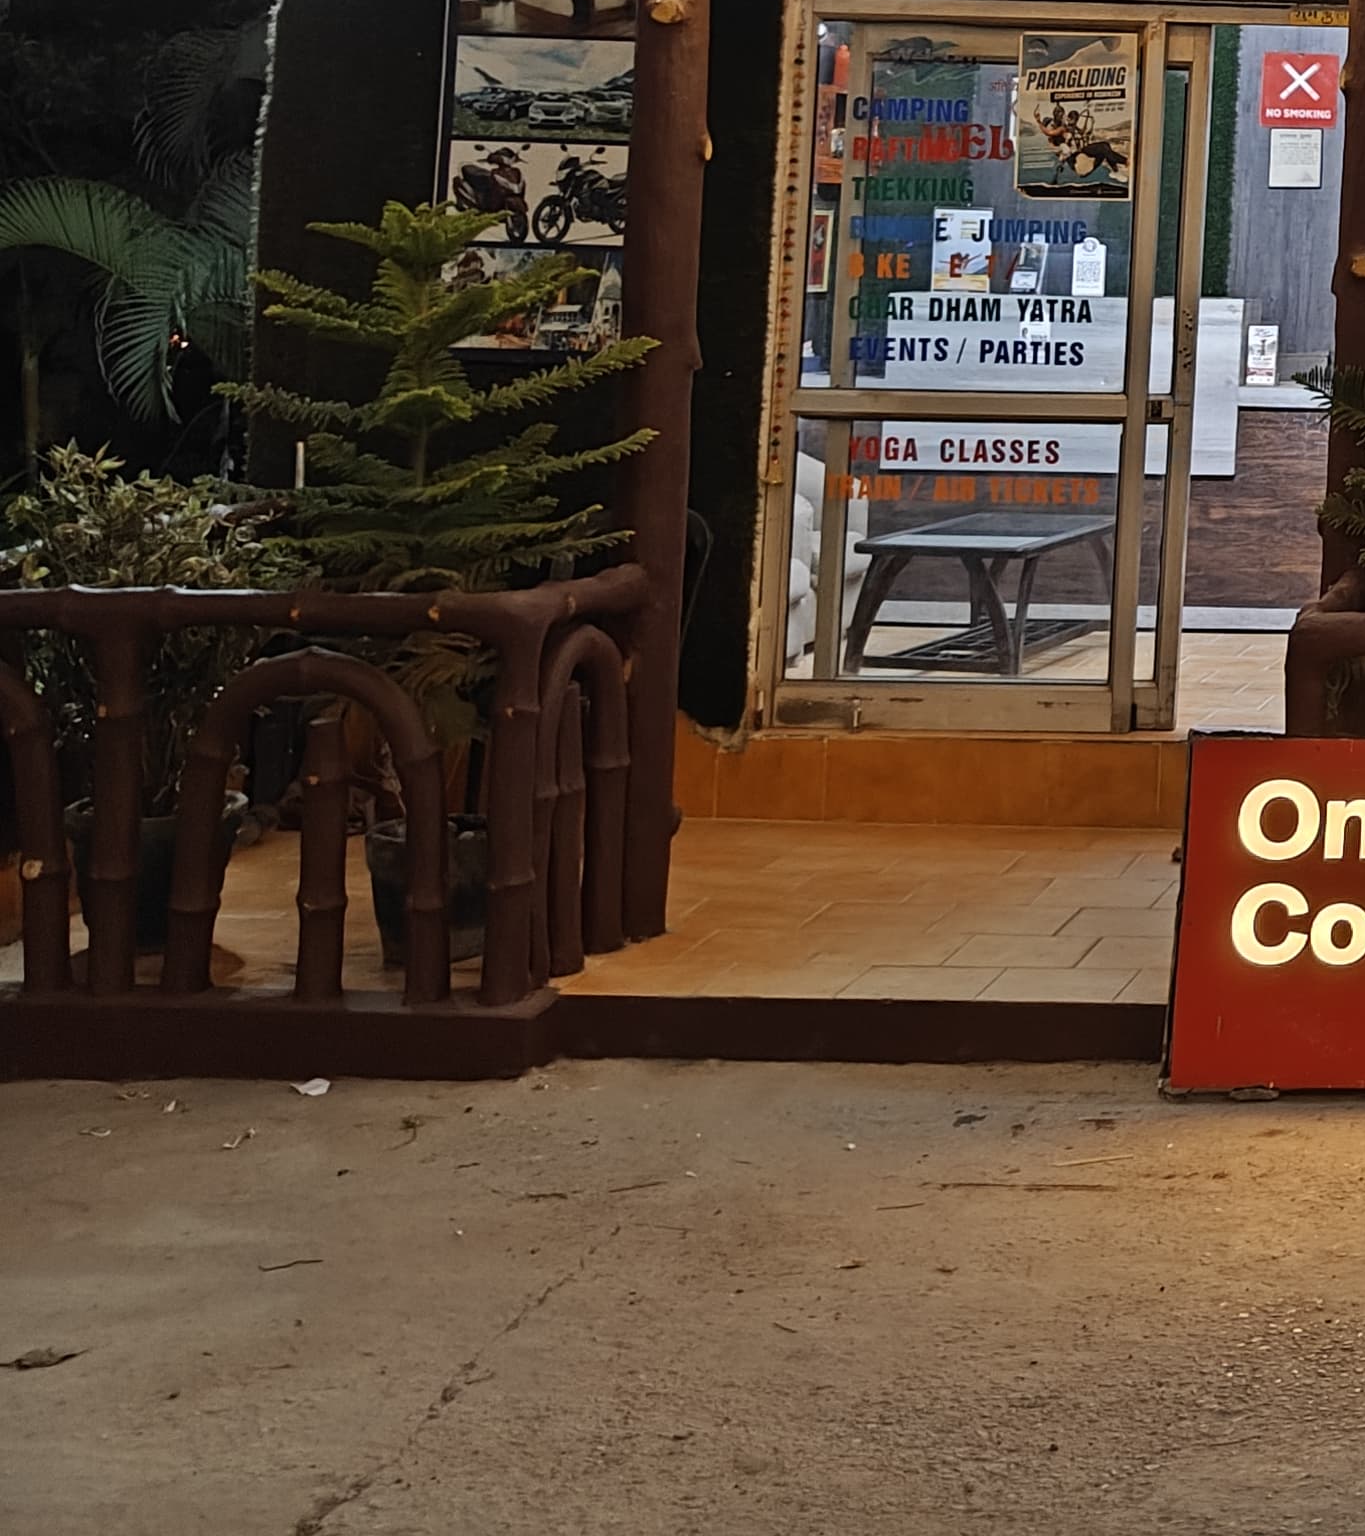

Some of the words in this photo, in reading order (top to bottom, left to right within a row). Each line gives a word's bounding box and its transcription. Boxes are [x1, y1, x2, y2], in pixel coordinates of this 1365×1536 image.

[1026, 66, 1127, 92] PARAGLIDING
[853, 96, 969, 123] CAMPING
[1266, 108, 1280, 119] NO
[1283, 108, 1332, 120] SMOKING
[851, 176, 975, 203] TREKKING
[971, 218, 1088, 244] JUMPING
[929, 297, 1001, 322] DHAM
[1018, 298, 1092, 324] YATRA
[850, 336, 949, 363] EVENTS
[979, 340, 1085, 366] PARTIES
[850, 436, 918, 462] YOGA
[940, 438, 1060, 465] CLASSES
